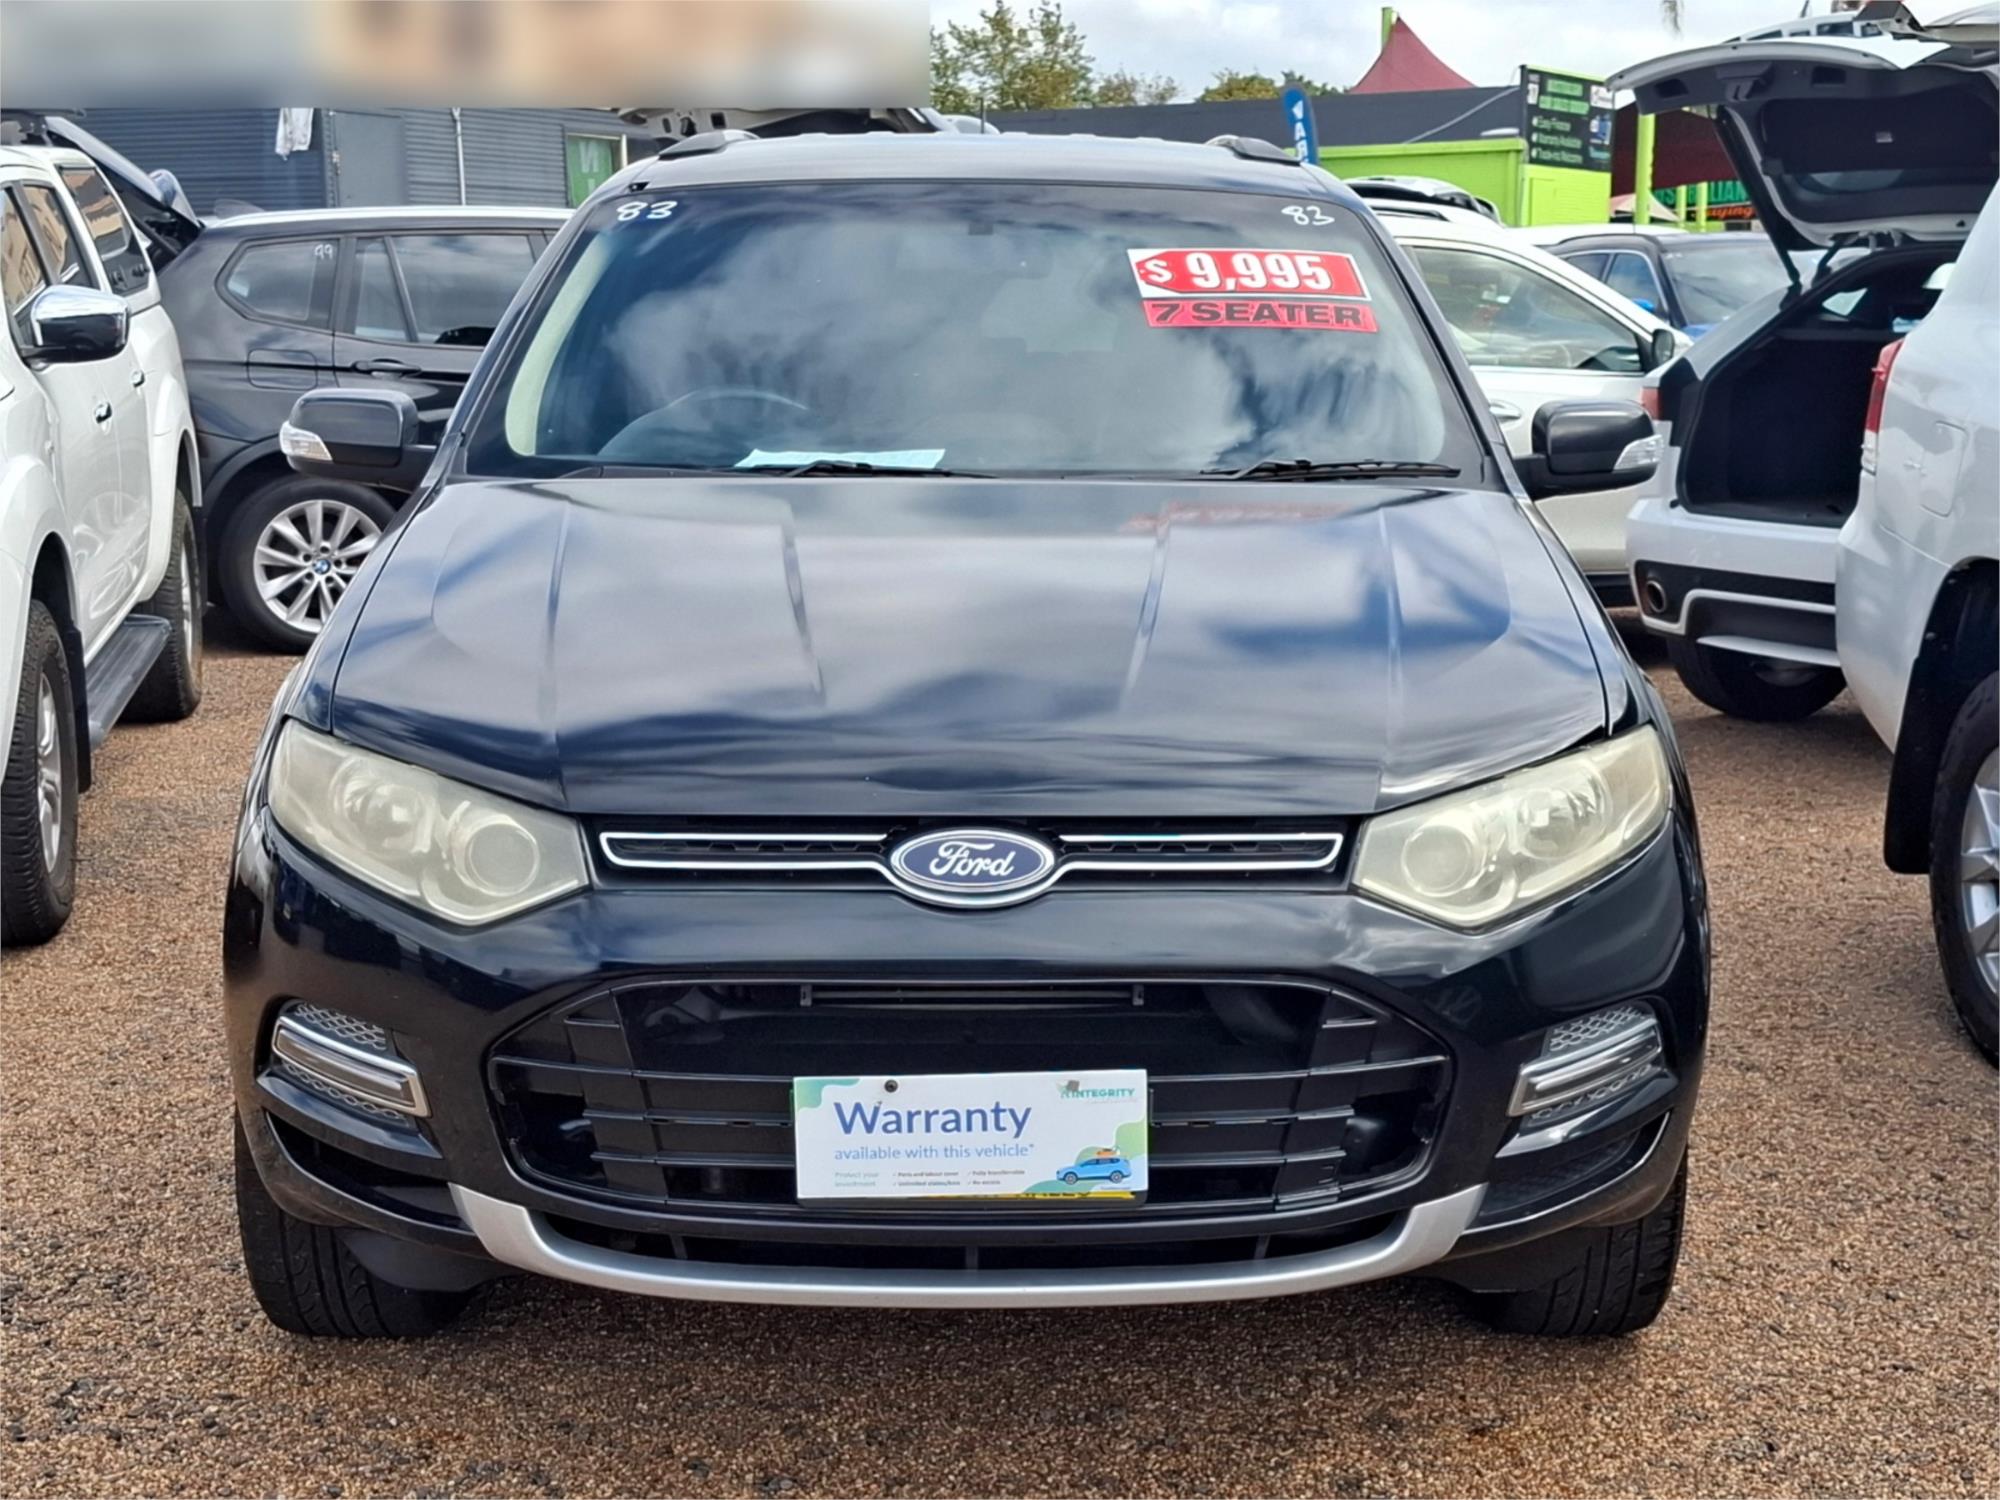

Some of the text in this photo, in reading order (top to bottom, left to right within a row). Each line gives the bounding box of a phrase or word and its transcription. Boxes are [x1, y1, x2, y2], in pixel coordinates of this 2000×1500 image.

[616, 200, 677, 222] 83
[1281, 205, 1335, 226] 83
[1143, 252, 1332, 291] $ 9,995
[1152, 303, 1362, 325] 7 SEATER
[929, 841, 1017, 876] Ford
[833, 1101, 1032, 1139] Warranty
[834, 1145, 900, 1161] available
[905, 1145, 938, 1159] with
[943, 1144, 971, 1158] this
